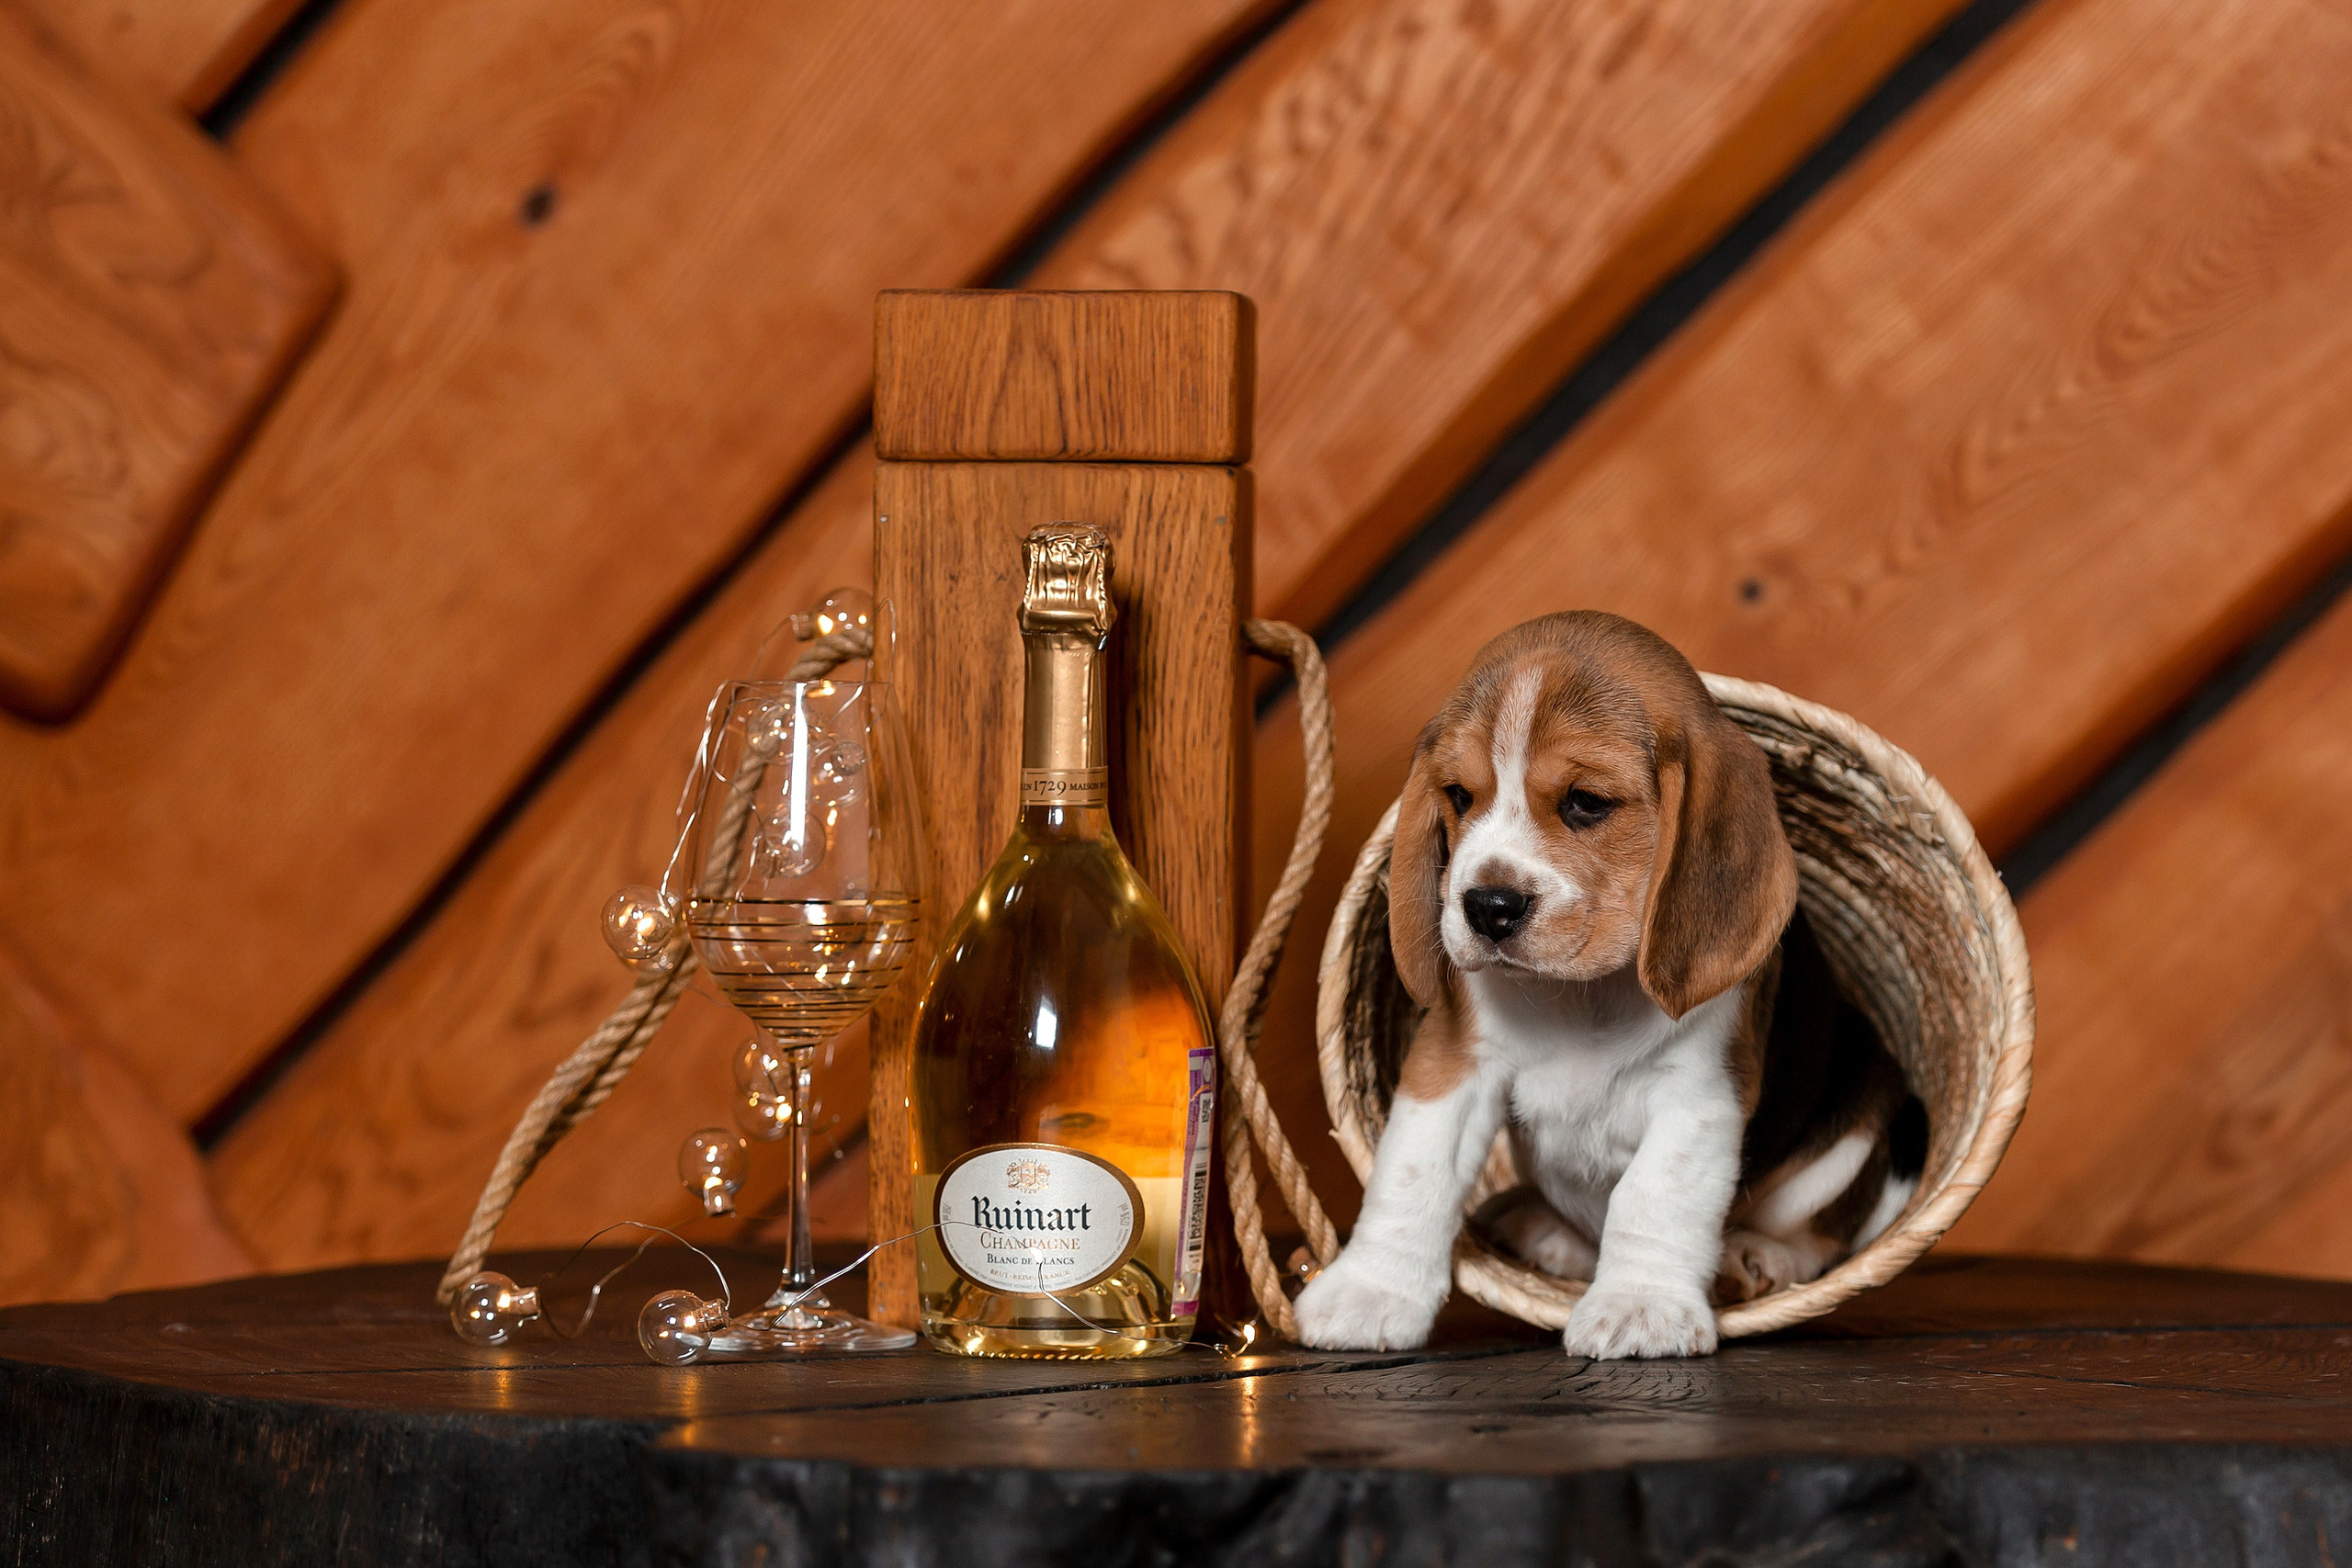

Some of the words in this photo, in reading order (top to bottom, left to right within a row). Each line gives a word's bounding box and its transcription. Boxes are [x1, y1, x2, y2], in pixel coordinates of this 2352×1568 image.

[1034, 780, 1067, 795] 1729
[1069, 782, 1100, 791] MAISON
[971, 1195, 1091, 1231] Ruinart
[980, 1231, 1080, 1250] CHAMPAGNE
[987, 1253, 1019, 1265] BLANC
[1021, 1256, 1033, 1265] DE
[1035, 1257, 1075, 1265] LANCS
[989, 1269, 1009, 1279] BRUT
[1043, 1269, 1070, 1280] RANCE
